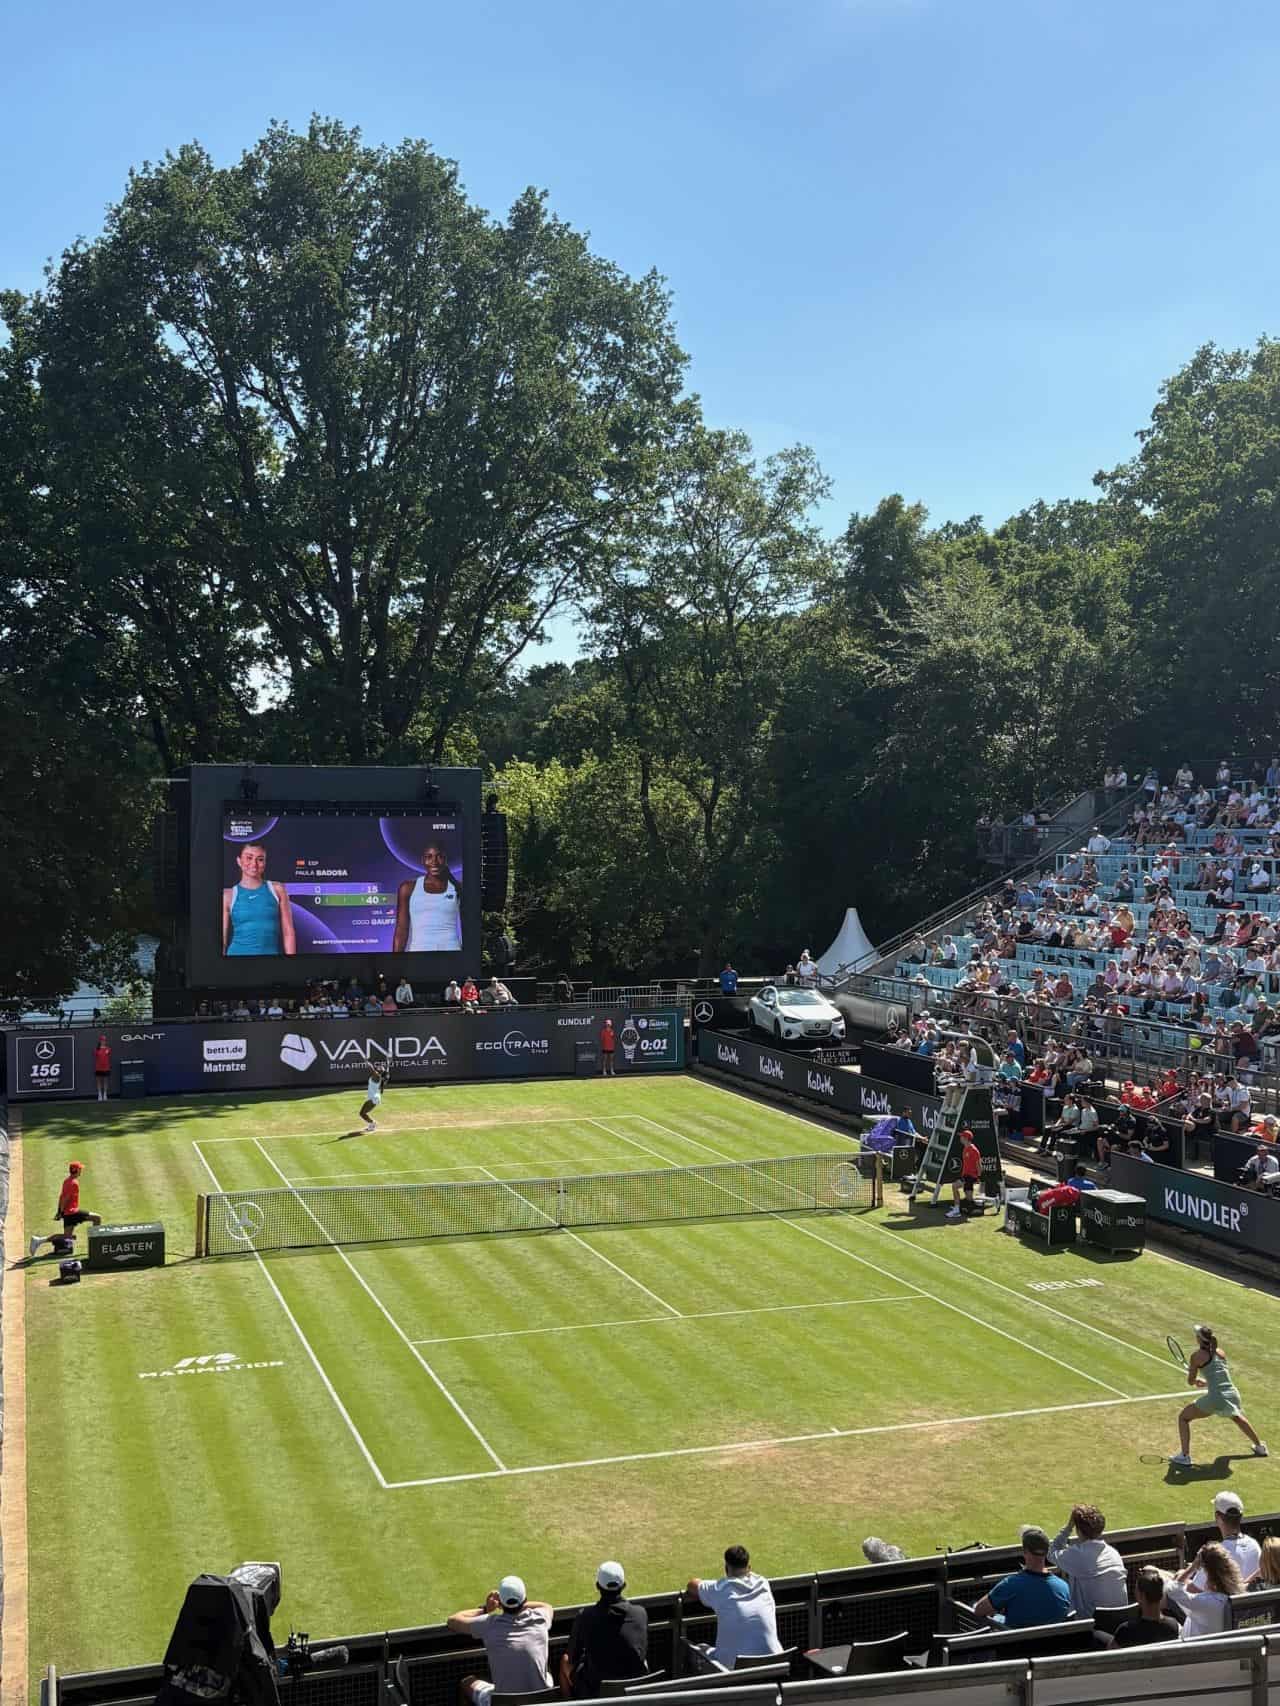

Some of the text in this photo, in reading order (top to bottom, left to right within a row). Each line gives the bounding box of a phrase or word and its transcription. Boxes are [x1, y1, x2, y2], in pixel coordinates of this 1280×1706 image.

[314, 896, 380, 905] 0 40
[121, 1033, 166, 1041] GANT
[206, 1046, 243, 1055] bett1.de
[320, 1036, 447, 1060] VANDA
[640, 1038, 667, 1050] 0:01
[30, 1063, 61, 1077] 156
[203, 1062, 247, 1072] Matratze
[329, 1060, 429, 1070] PHARMCEUTICALS
[760, 1056, 784, 1080] KaDeWe
[808, 1070, 834, 1095] KaDeWe
[922, 1106, 941, 1128] KaD
[102, 1241, 153, 1254] ELASTEN
[1025, 1278, 1104, 1291] BERLIN
[139, 1361, 284, 1378] MAMMOTION
